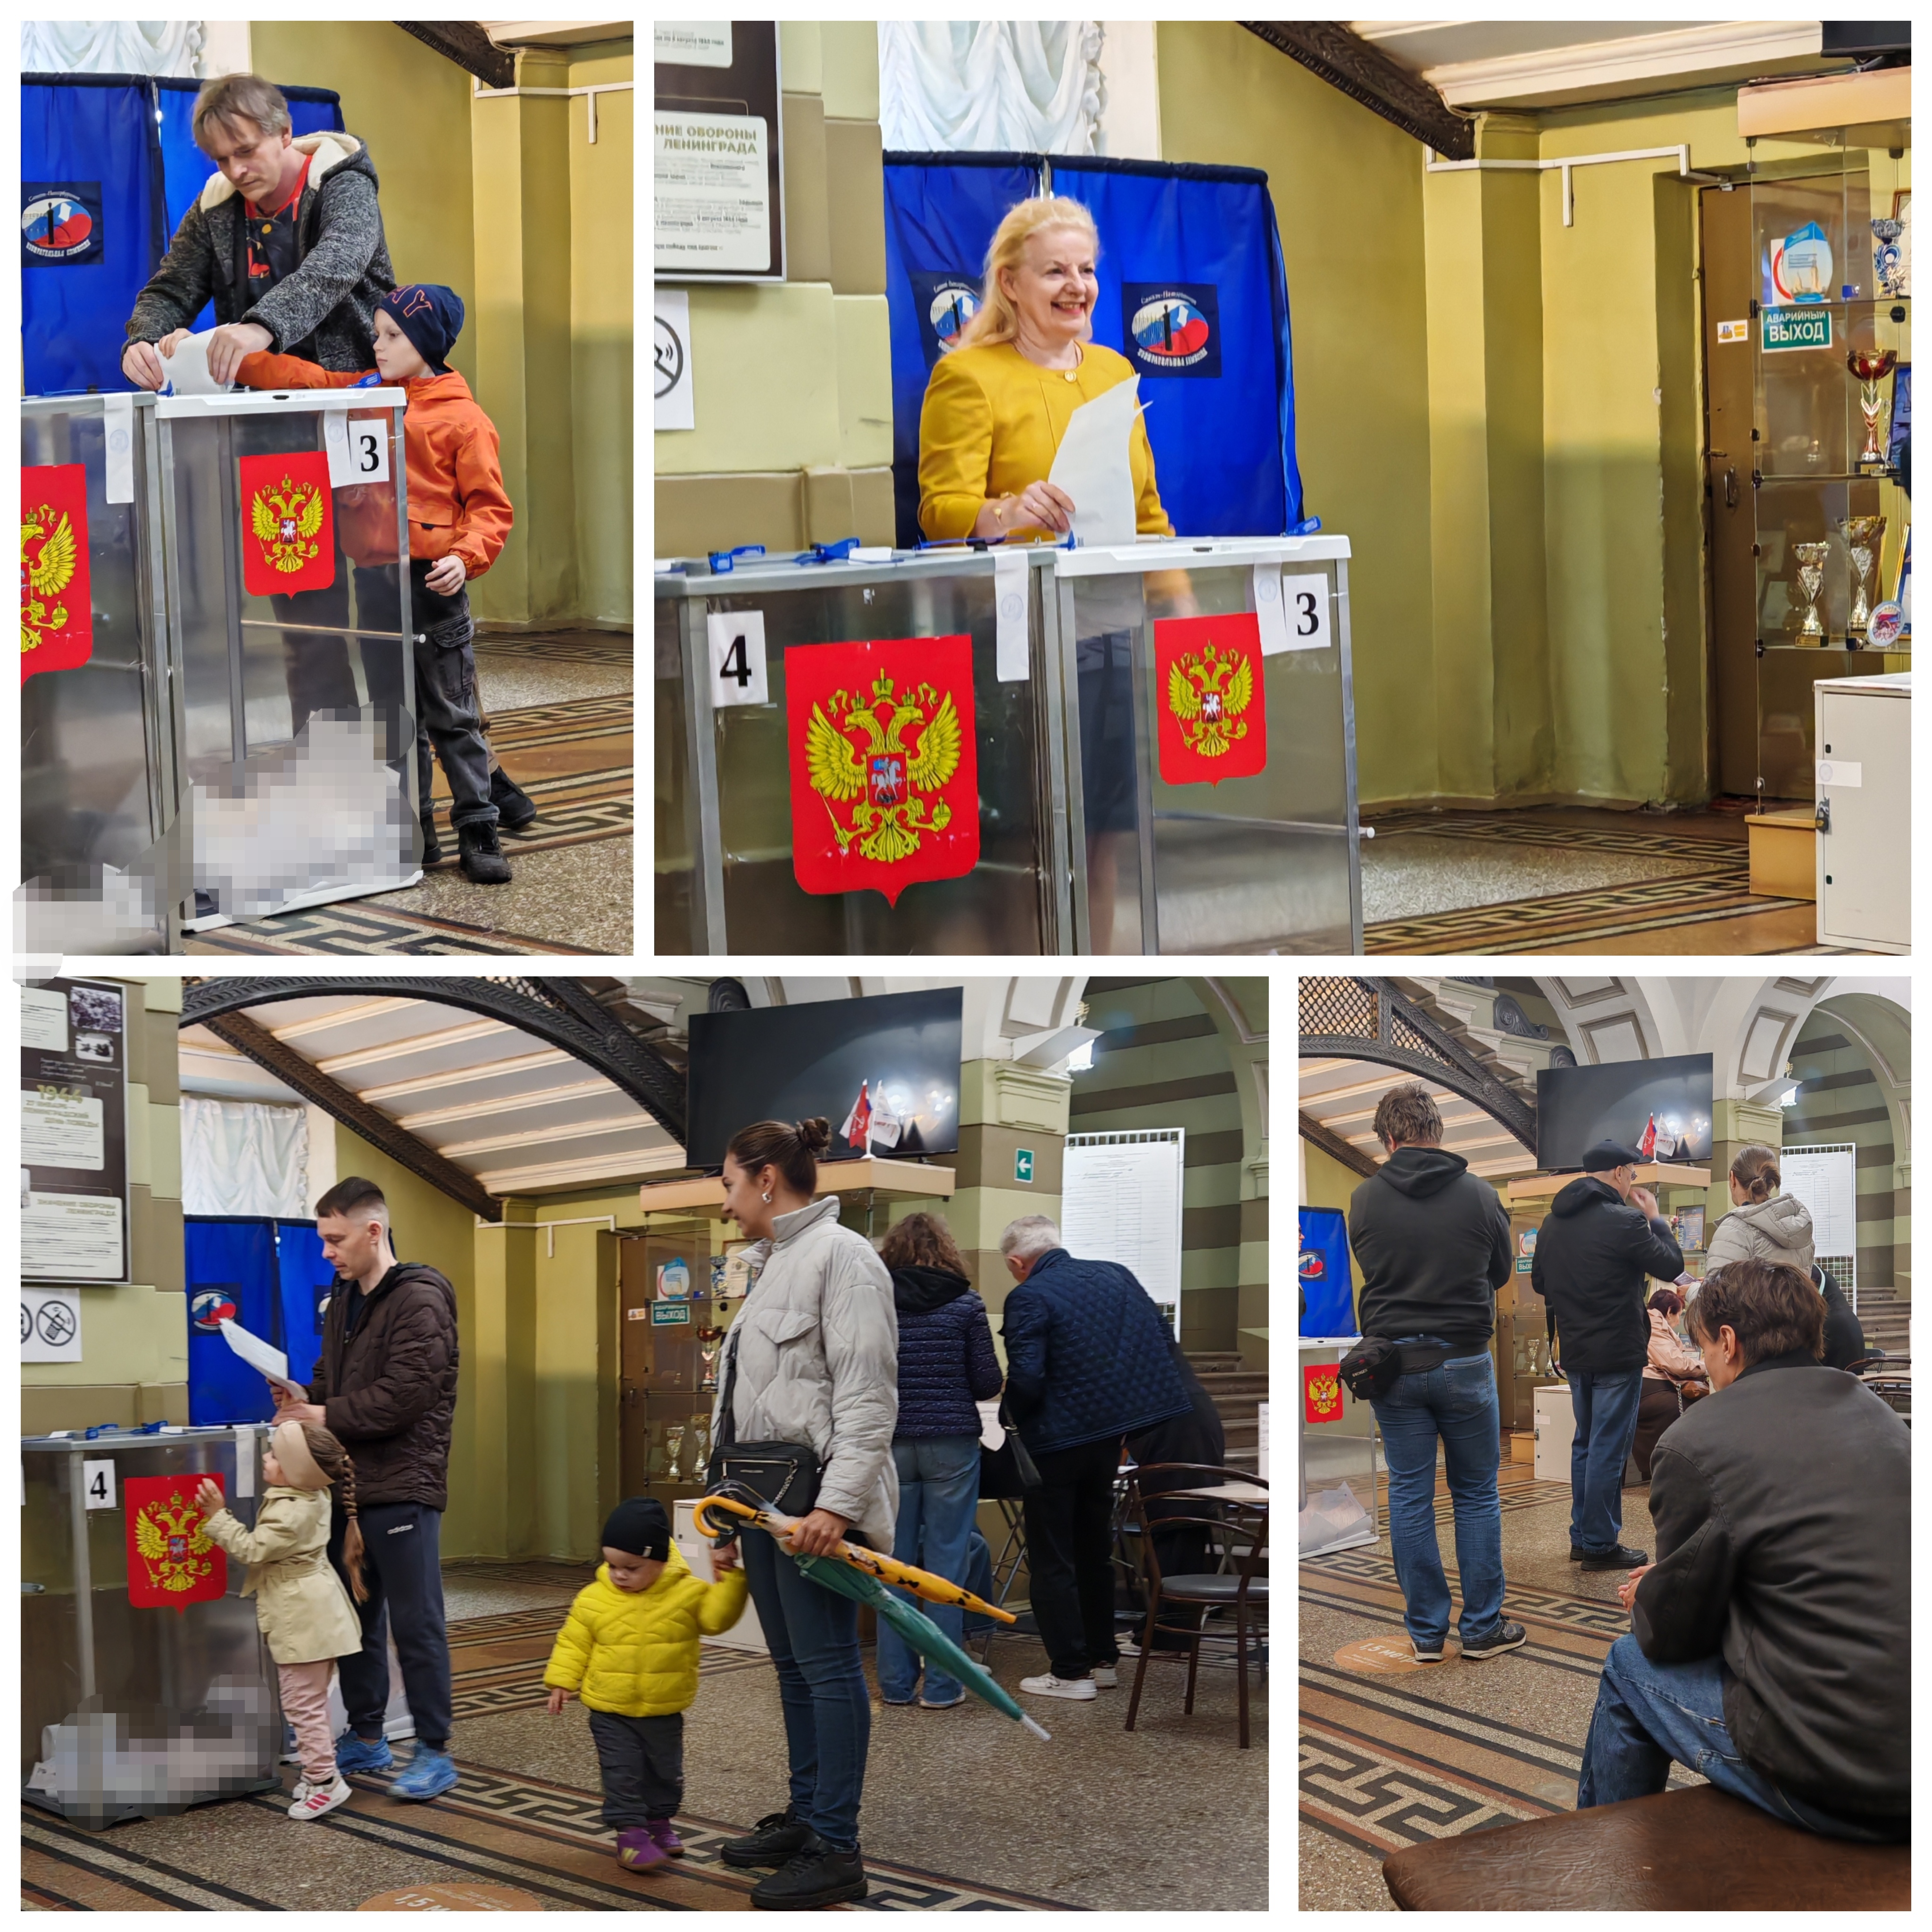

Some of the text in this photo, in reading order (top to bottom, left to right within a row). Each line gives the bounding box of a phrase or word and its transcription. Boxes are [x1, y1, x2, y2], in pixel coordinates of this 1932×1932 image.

[687, 126, 757, 140] ОБОРОНЫ
[664, 139, 757, 155] ЛЕНИНГРАДА
[1767, 310, 1826, 323] АВАРИЙНЫЙ
[1770, 322, 1824, 342] ВЫХОД
[359, 434, 379, 472] 3
[1296, 592, 1319, 636] 3
[719, 634, 752, 687] 4
[36, 1084, 83, 1103] 1944
[90, 1471, 107, 1499] 4
[1359, 1643, 1385, 1652] 1,5
[394, 1893, 435, 1907] 1,5
